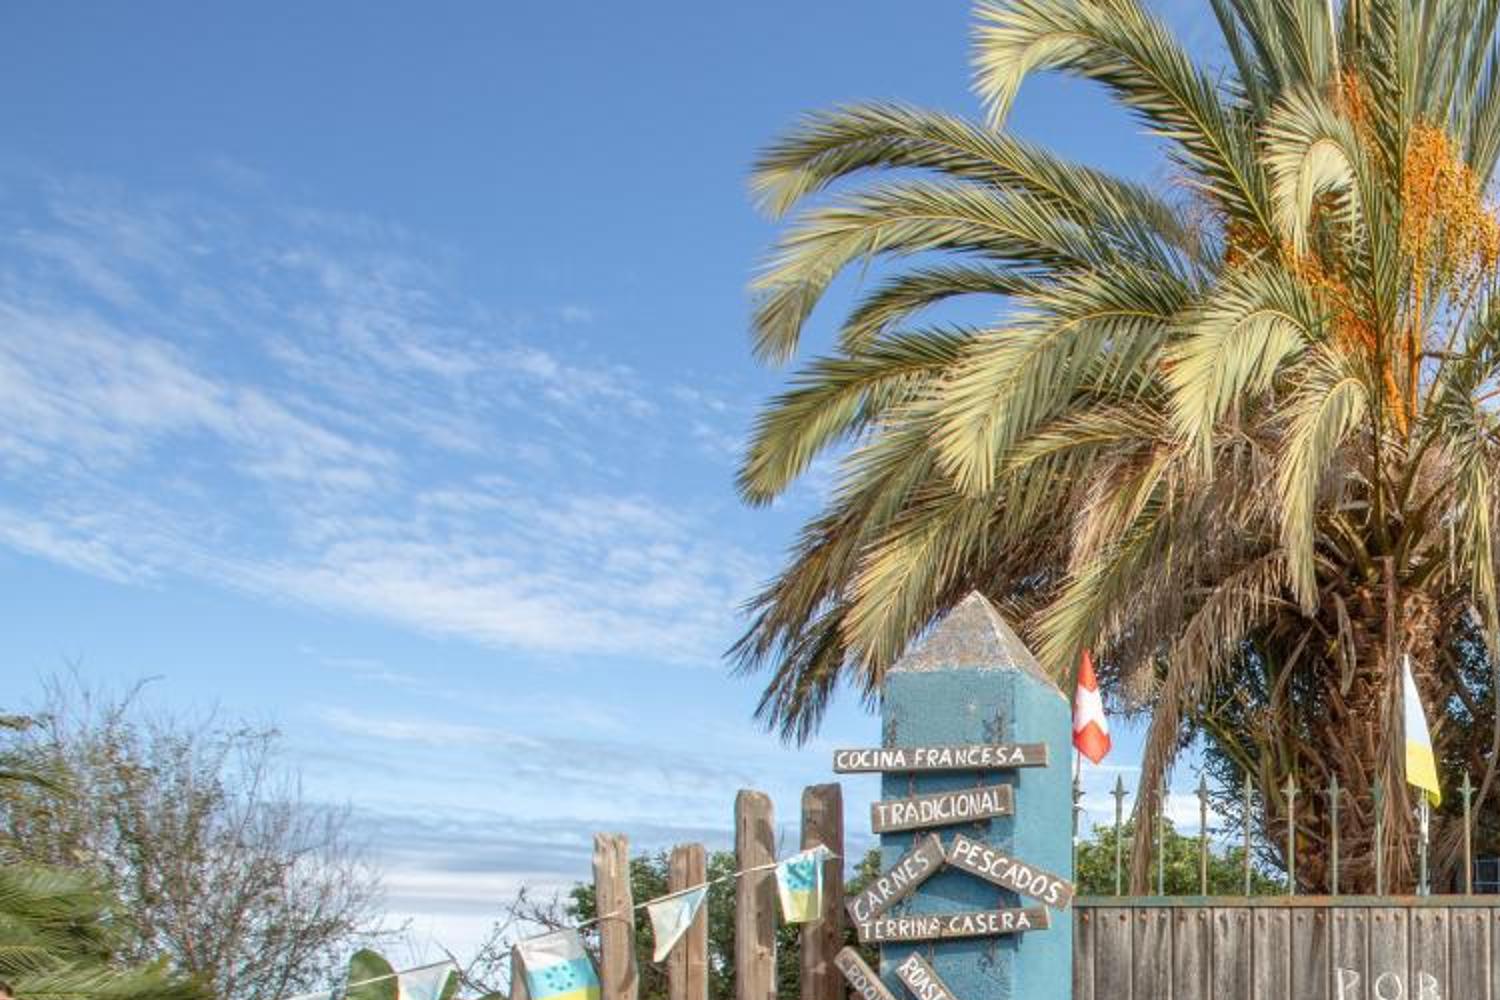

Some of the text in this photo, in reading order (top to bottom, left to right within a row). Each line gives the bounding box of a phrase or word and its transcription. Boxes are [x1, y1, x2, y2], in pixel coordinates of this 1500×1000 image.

[836, 746, 1025, 770] COCINA FRANCESA
[878, 790, 1005, 828] TRADICIONAL
[853, 849, 930, 923] CARNES
[953, 836, 1063, 904] PESCADOS
[860, 911, 1032, 941] TERRINA CASERA
